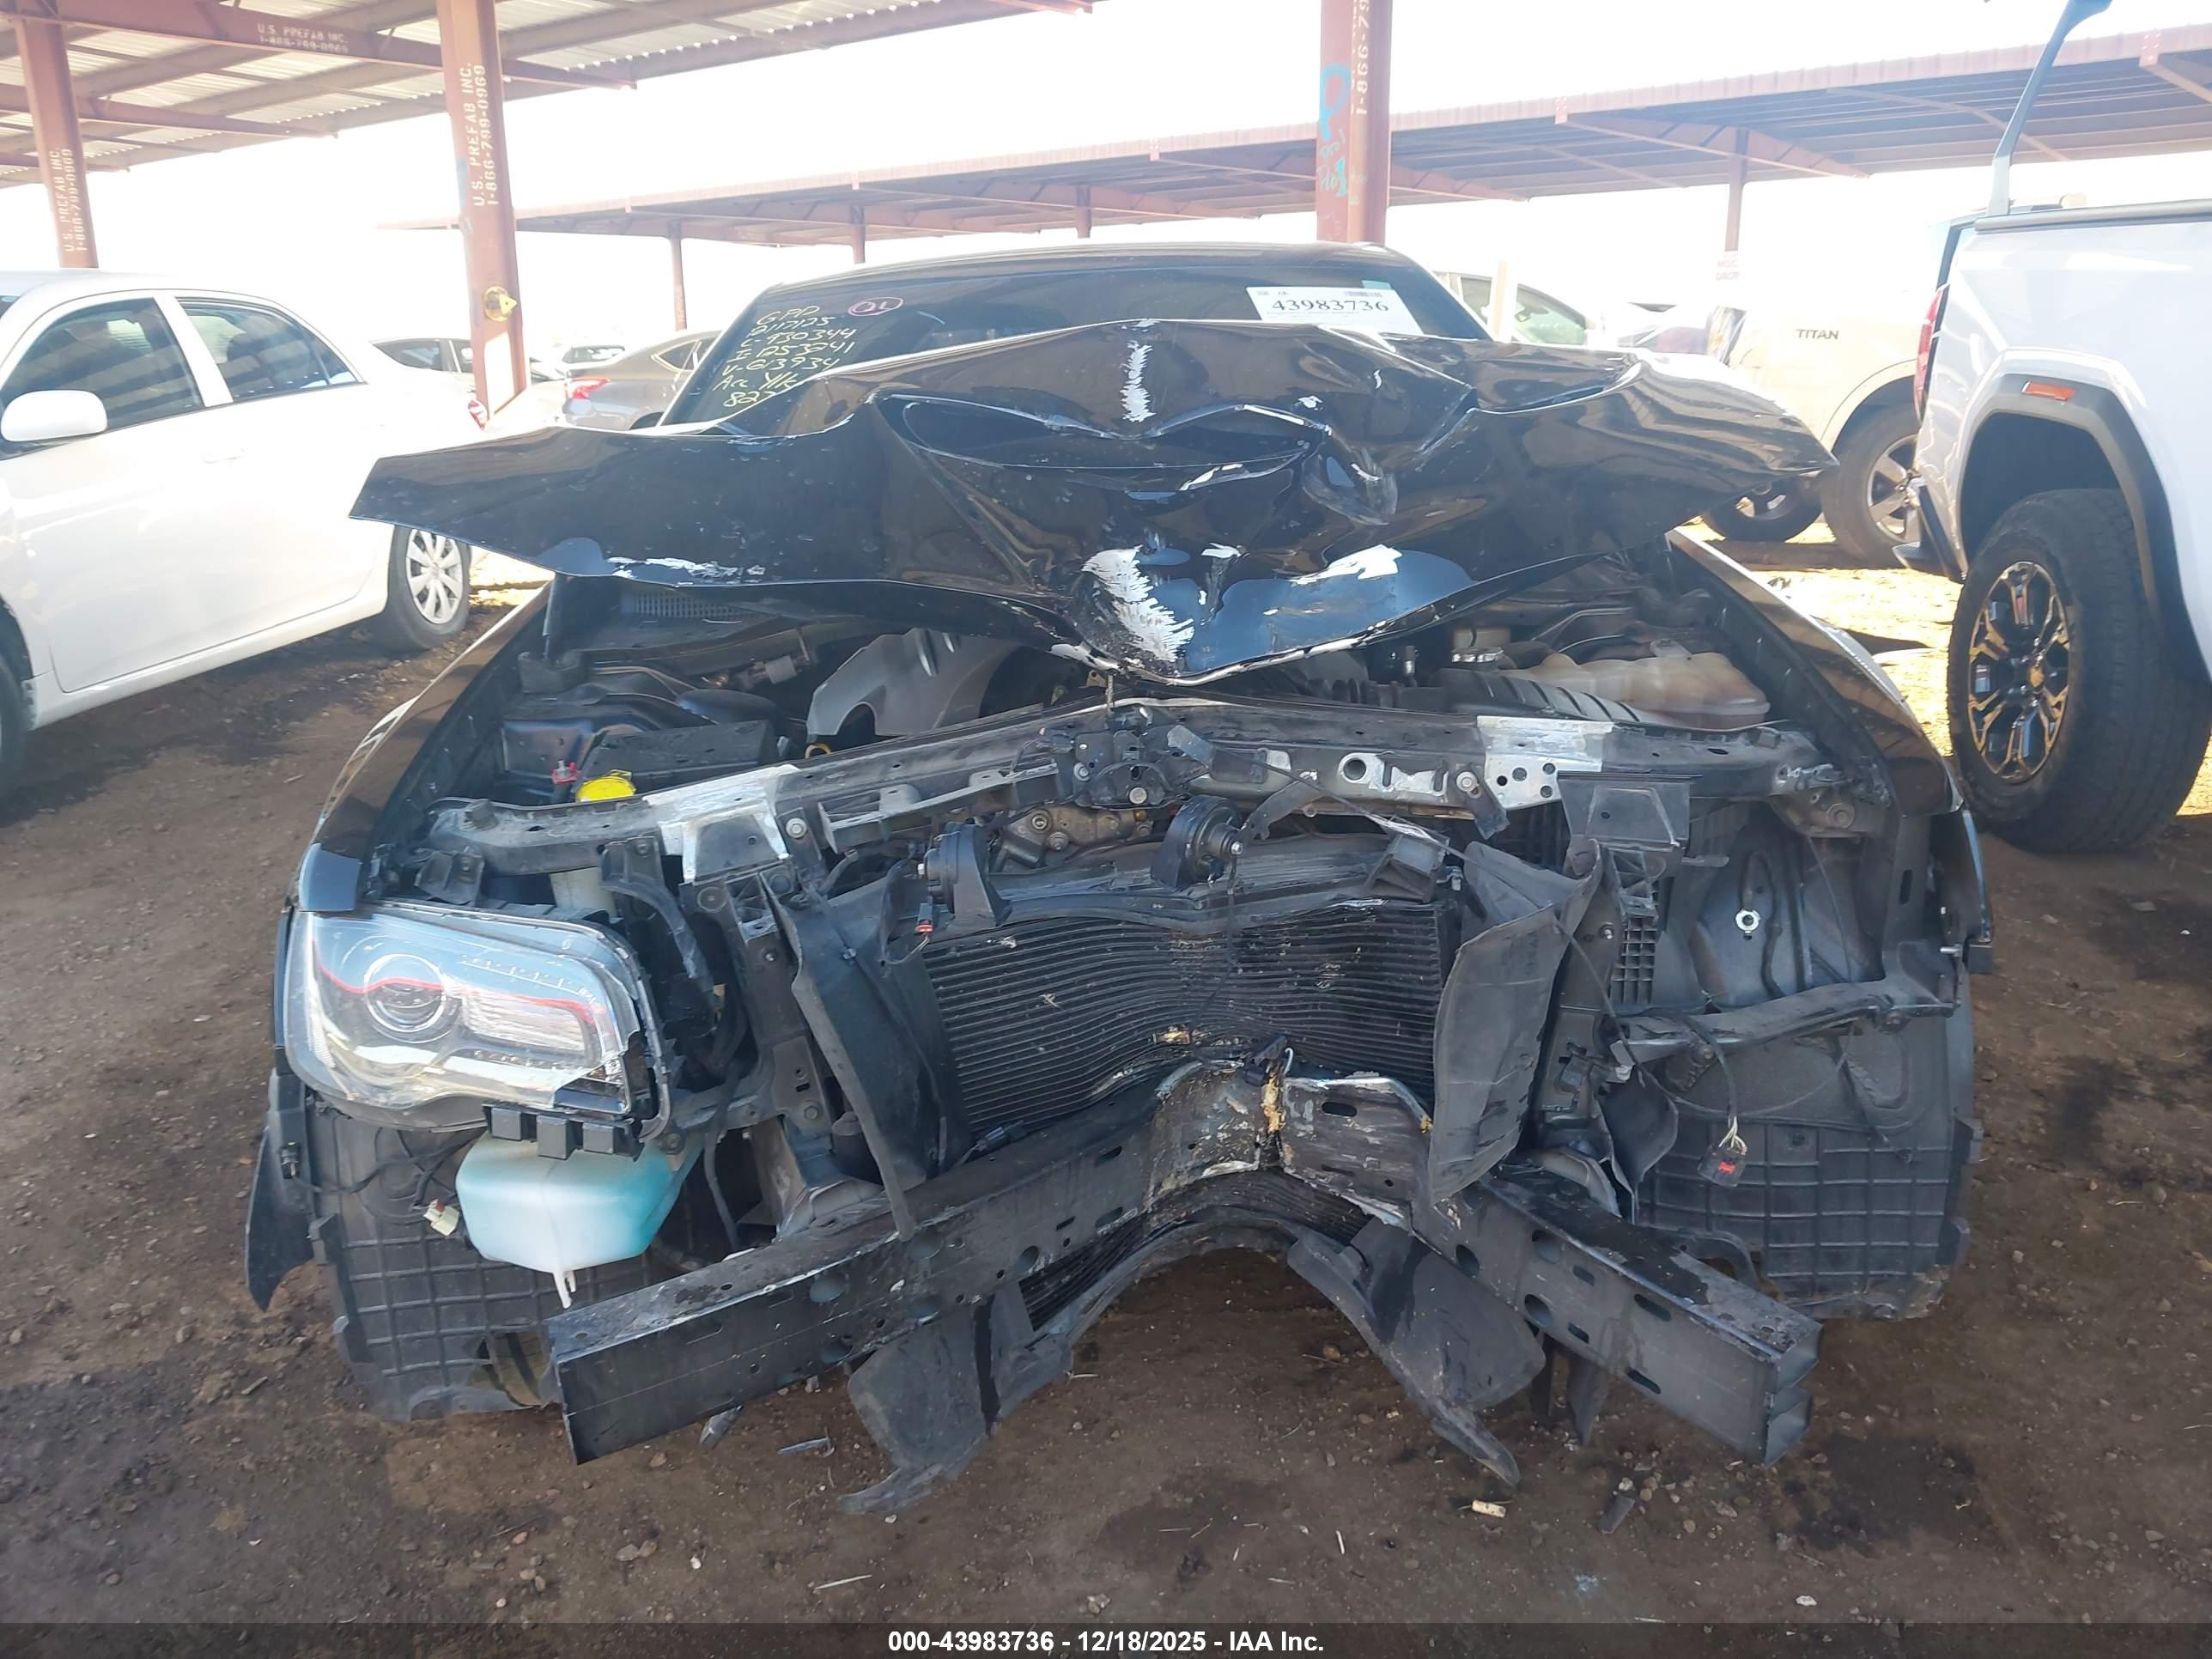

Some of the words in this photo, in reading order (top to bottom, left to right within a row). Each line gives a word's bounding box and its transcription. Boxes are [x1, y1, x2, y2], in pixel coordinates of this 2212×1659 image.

[459, 63, 474, 94] INC.
[463, 101, 482, 167] PREFAB
[473, 64, 500, 206] 1-866-799-0969
[472, 177, 486, 206] U.S.
[1272, 299, 1389, 312] 43983736
[1796, 329, 1840, 340] TITAN
